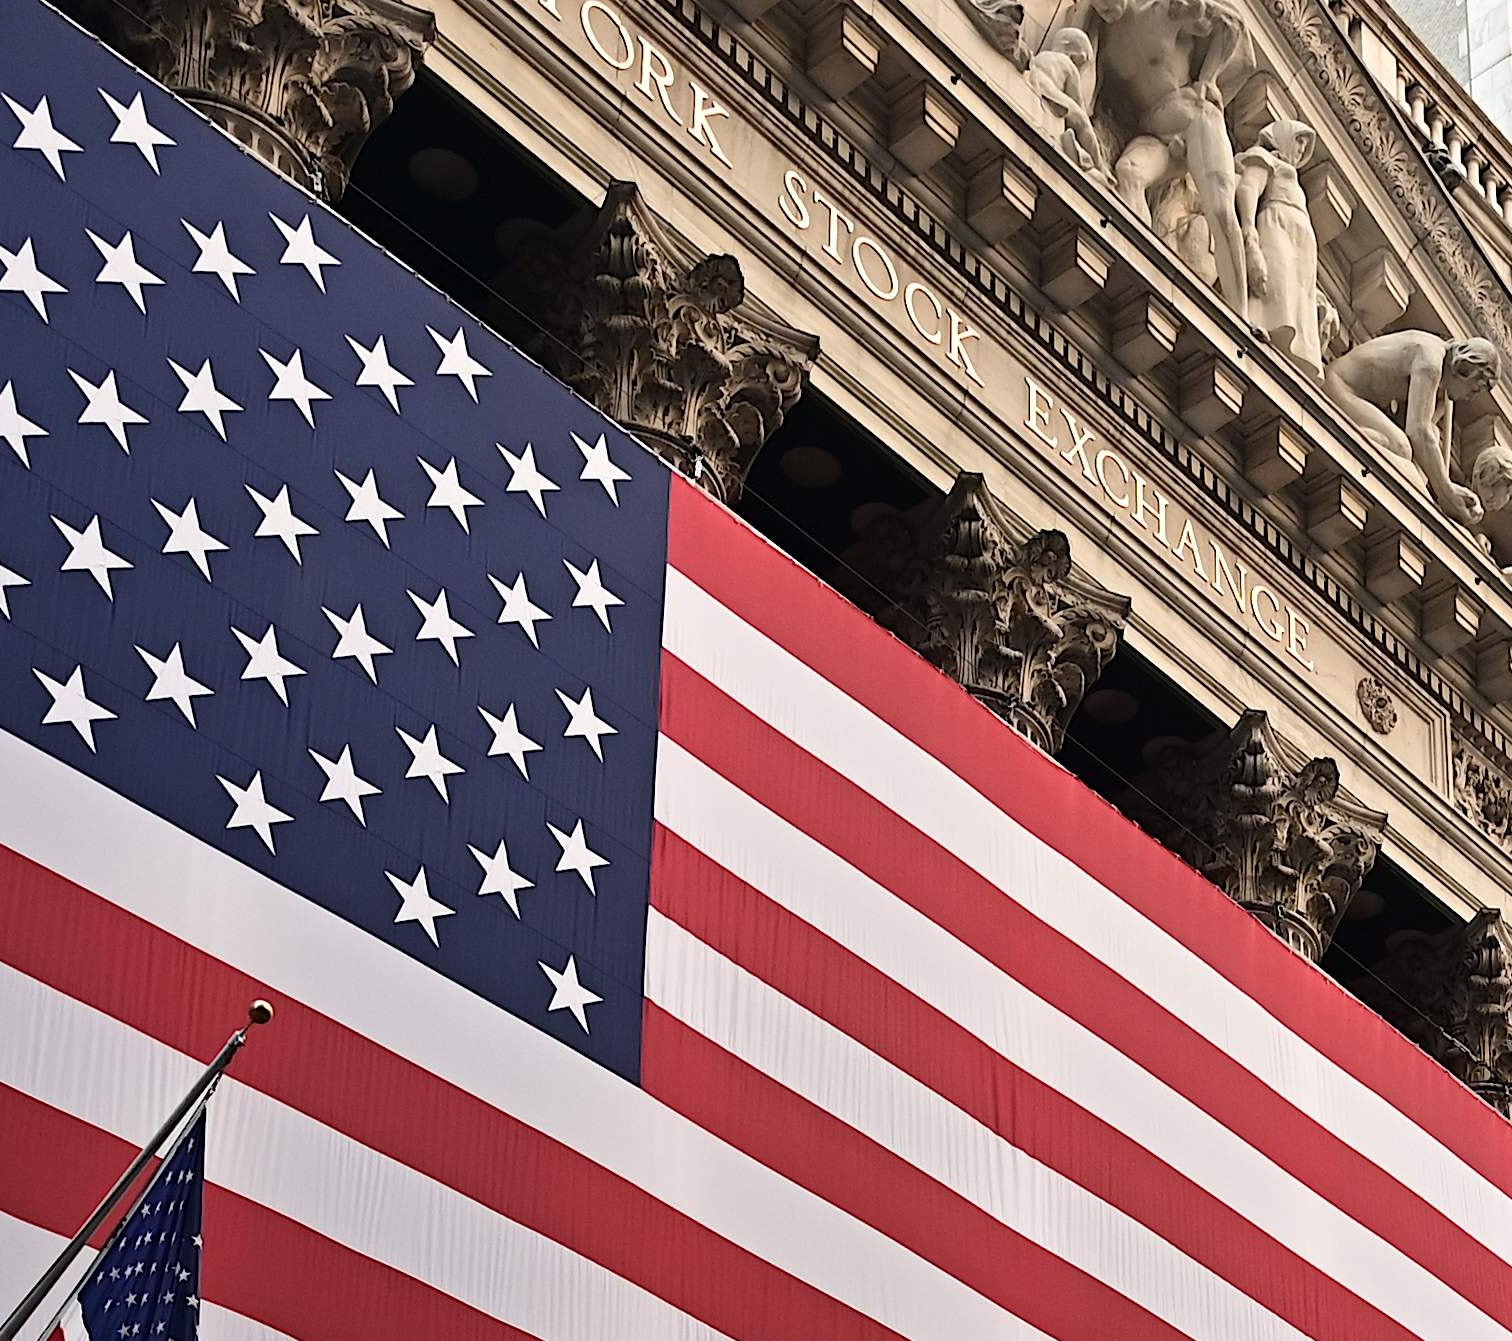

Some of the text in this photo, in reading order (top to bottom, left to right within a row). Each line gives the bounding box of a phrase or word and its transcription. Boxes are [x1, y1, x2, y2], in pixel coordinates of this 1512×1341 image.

[540, 0, 1315, 673] ORK STOCK EXCHANGE
